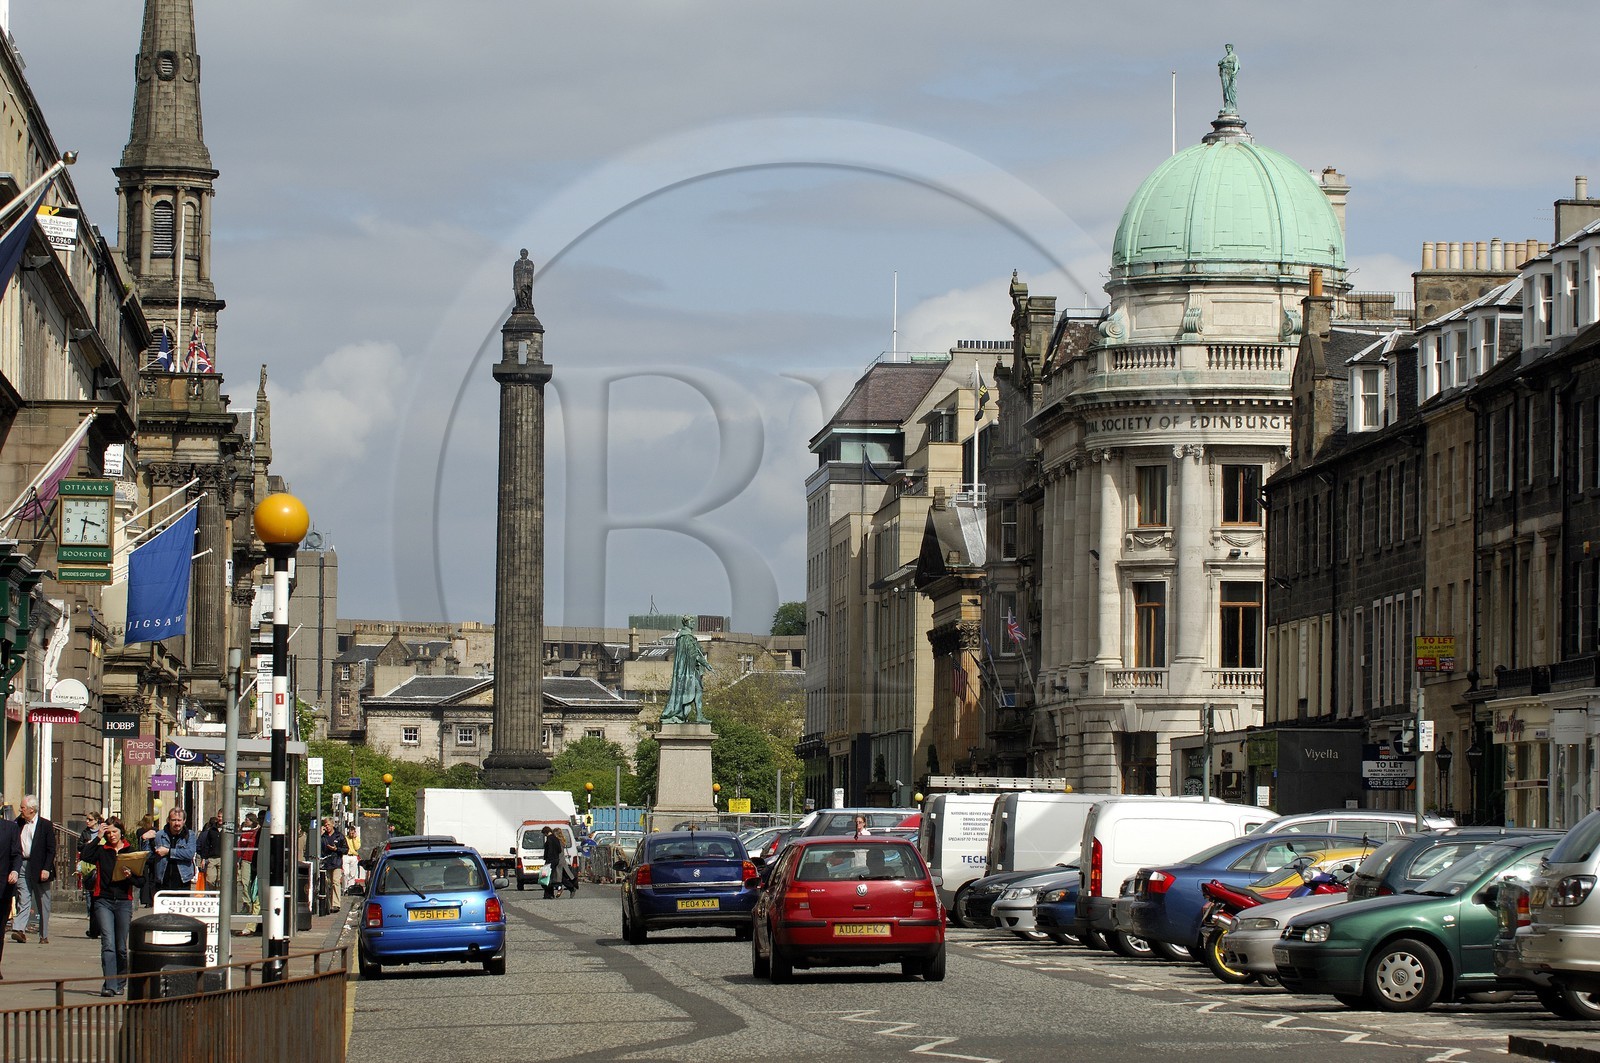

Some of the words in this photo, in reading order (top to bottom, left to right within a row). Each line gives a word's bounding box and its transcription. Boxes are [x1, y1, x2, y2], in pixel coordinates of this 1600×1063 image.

[1101, 416, 1152, 432] SOCIETY
[1159, 416, 1179, 429] OF
[64, 484, 109, 492] OTTAKAR'S
[62, 550, 108, 558] BOOKSTORE
[1422, 637, 1435, 645] TO
[1437, 637, 1454, 645] LET
[277, 695, 284, 704] 1
[31, 711, 78, 723] Britannia
[126, 740, 155, 750] Phase
[128, 751, 152, 762] Eight
[1304, 748, 1339, 761] Viyella
[1375, 761, 1387, 769] TO
[1389, 761, 1404, 769] LET
[168, 906, 216, 914] STORE
